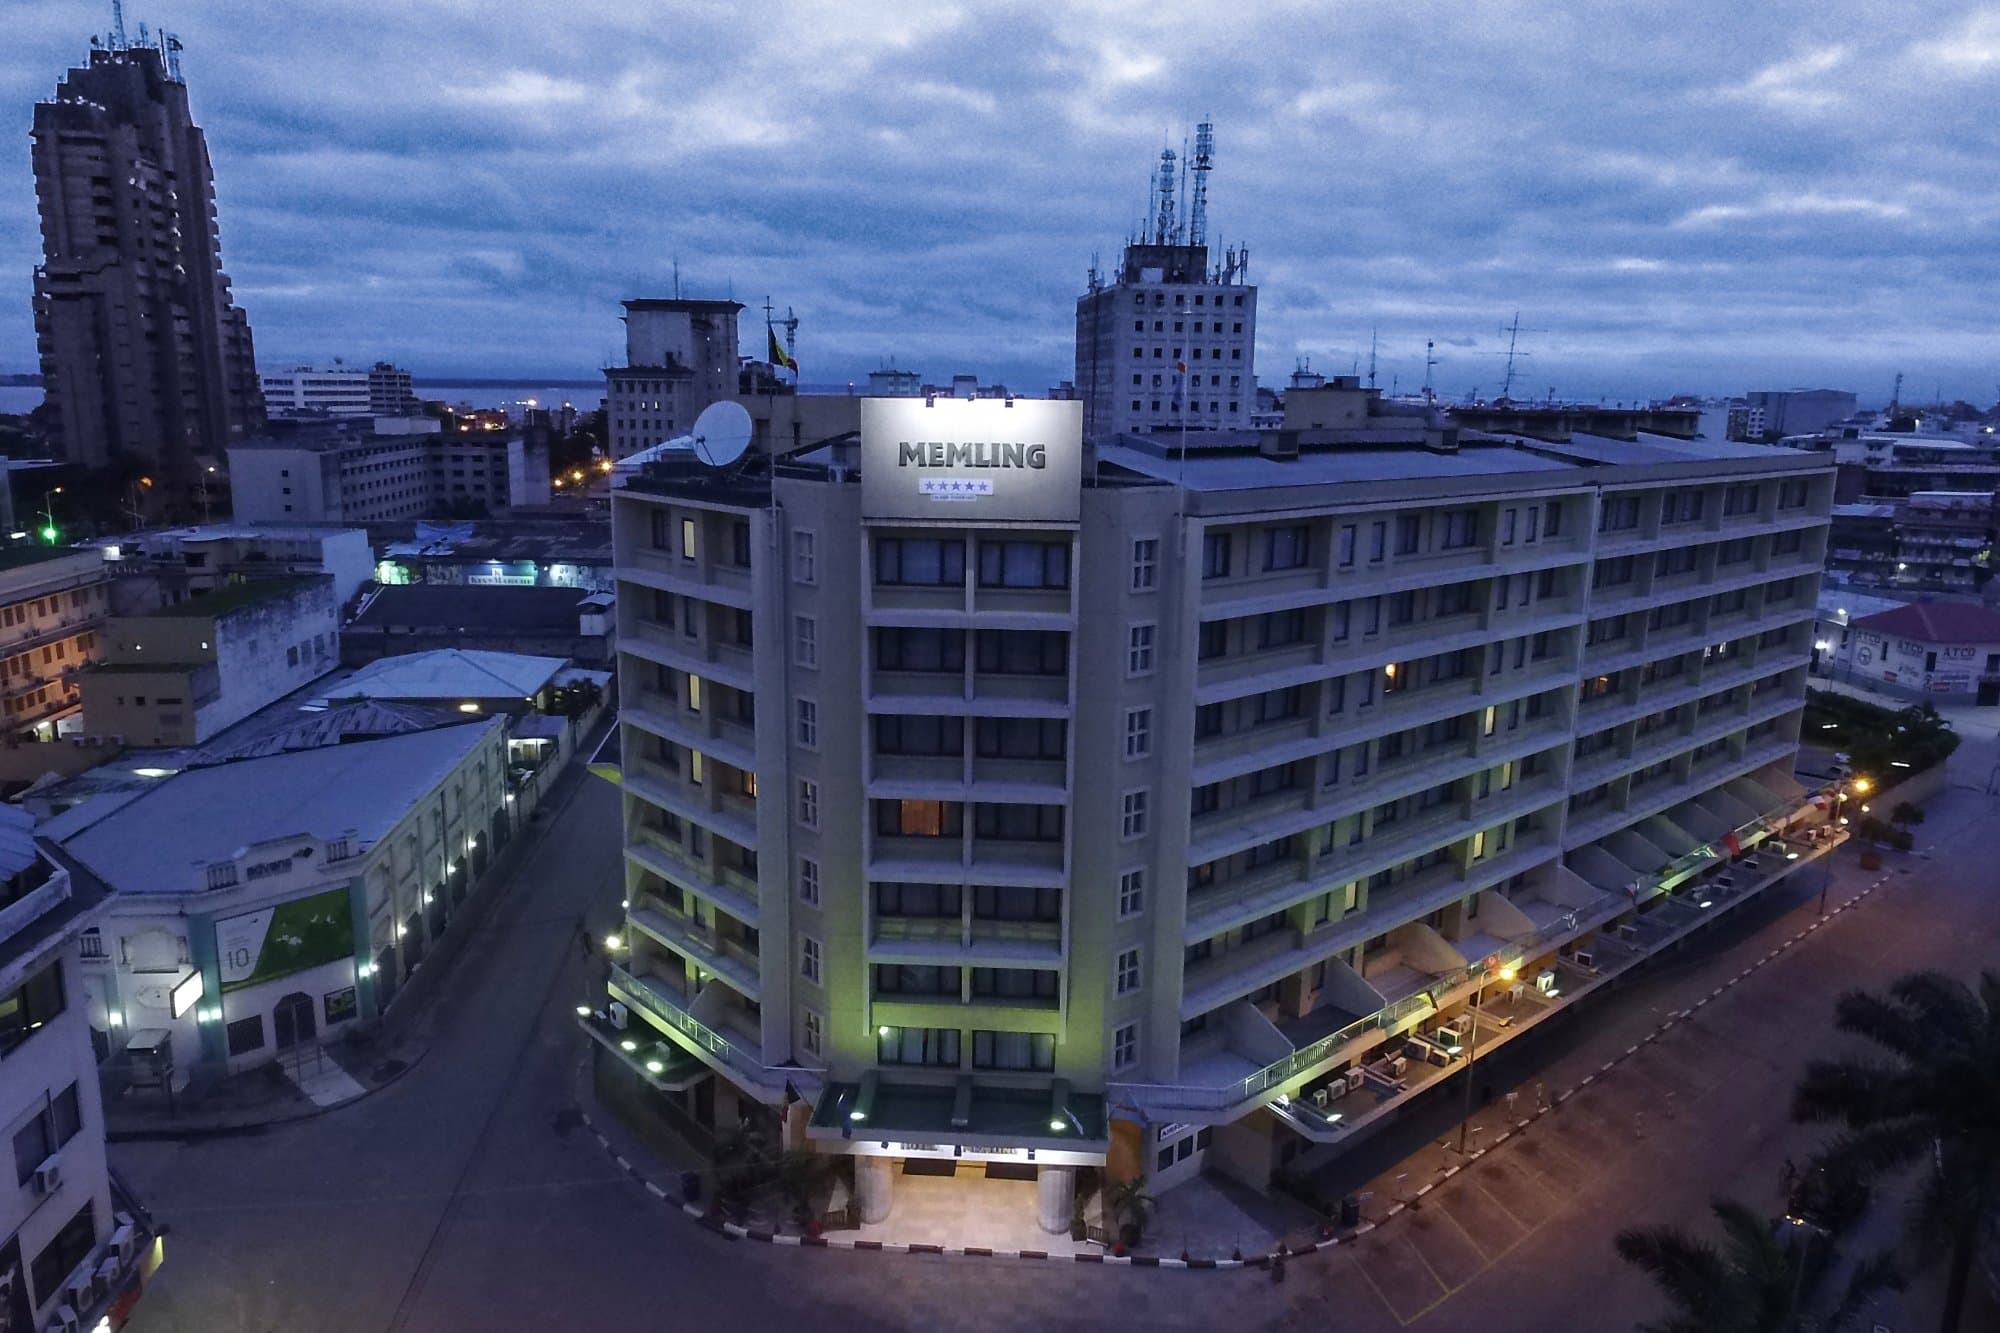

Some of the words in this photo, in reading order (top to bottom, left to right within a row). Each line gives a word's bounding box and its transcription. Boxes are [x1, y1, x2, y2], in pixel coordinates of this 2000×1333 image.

[899, 442, 1046, 469] MEMLING
[1943, 647, 1976, 657] ATCO
[228, 947, 249, 970] 10
